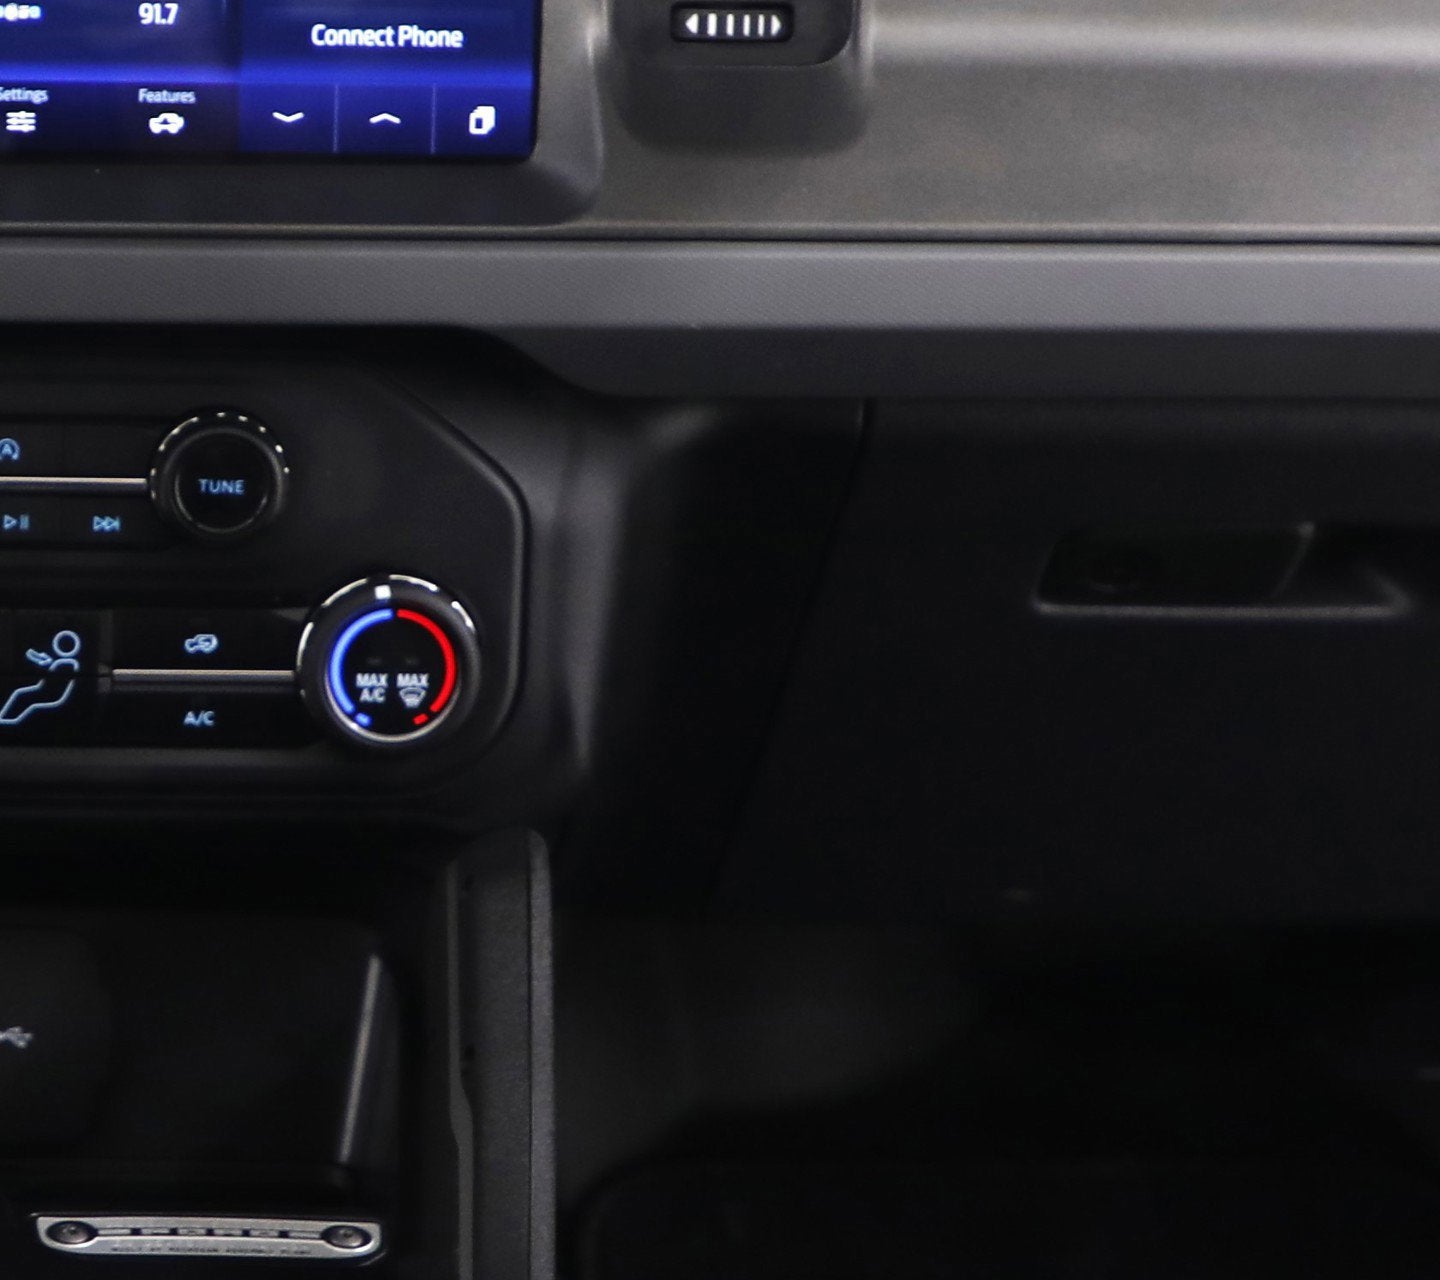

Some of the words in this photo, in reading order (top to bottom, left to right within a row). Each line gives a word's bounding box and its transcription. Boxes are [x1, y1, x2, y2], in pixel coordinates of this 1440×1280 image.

[137, 2, 181, 26] 91.7
[310, 23, 397, 49] Connect
[396, 24, 465, 49] Phone
[137, 87, 197, 105] Features
[199, 479, 244, 495] TUNE
[356, 673, 388, 689] MAX
[396, 673, 428, 688] MAX
[184, 710, 214, 726] A/C
